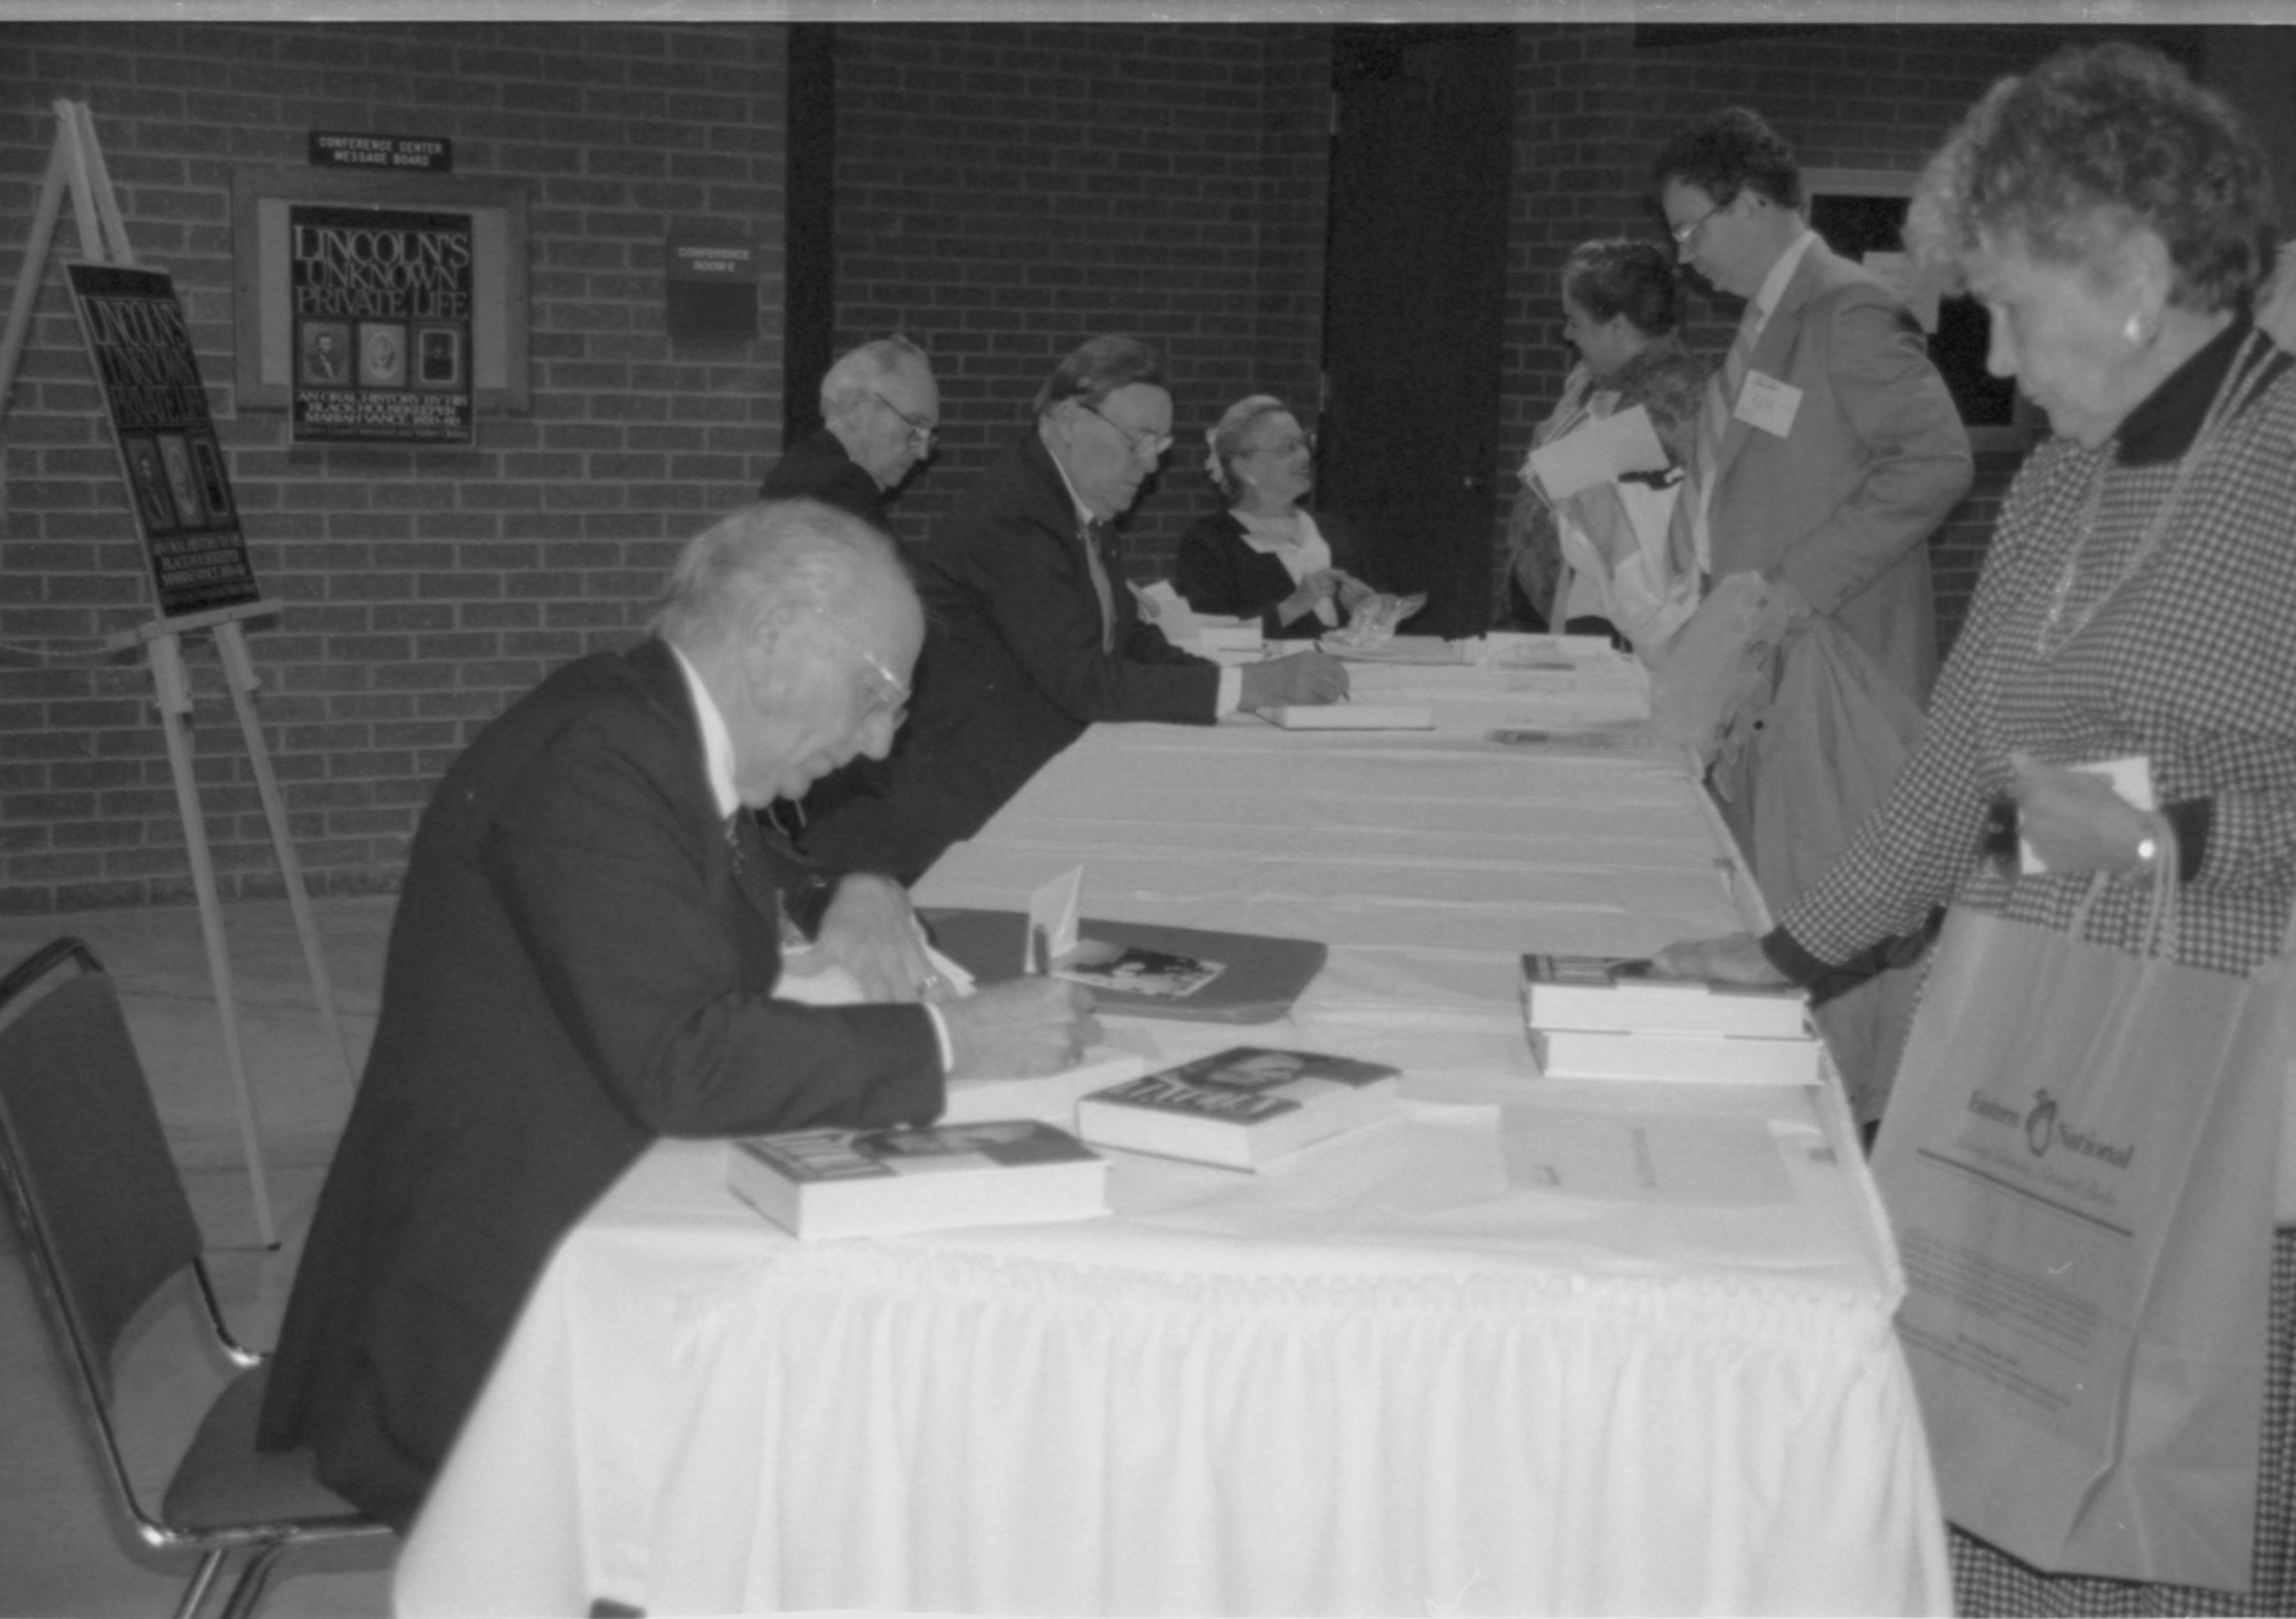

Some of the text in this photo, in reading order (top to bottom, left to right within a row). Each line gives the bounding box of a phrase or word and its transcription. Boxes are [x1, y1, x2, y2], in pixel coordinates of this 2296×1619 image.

[319, 136, 443, 154] CONFERENCE CENTER
[334, 150, 429, 166] MESSAGE BOARD
[293, 226, 469, 268] LINCOLN'S
[678, 247, 750, 261] CONFERENCE
[307, 259, 458, 291] UNKNOWN
[296, 287, 469, 318] PRIVATE LIFE
[79, 295, 189, 348] LINCOLN'S
[297, 391, 318, 402] AN
[2059, 1121, 2135, 1169] National
